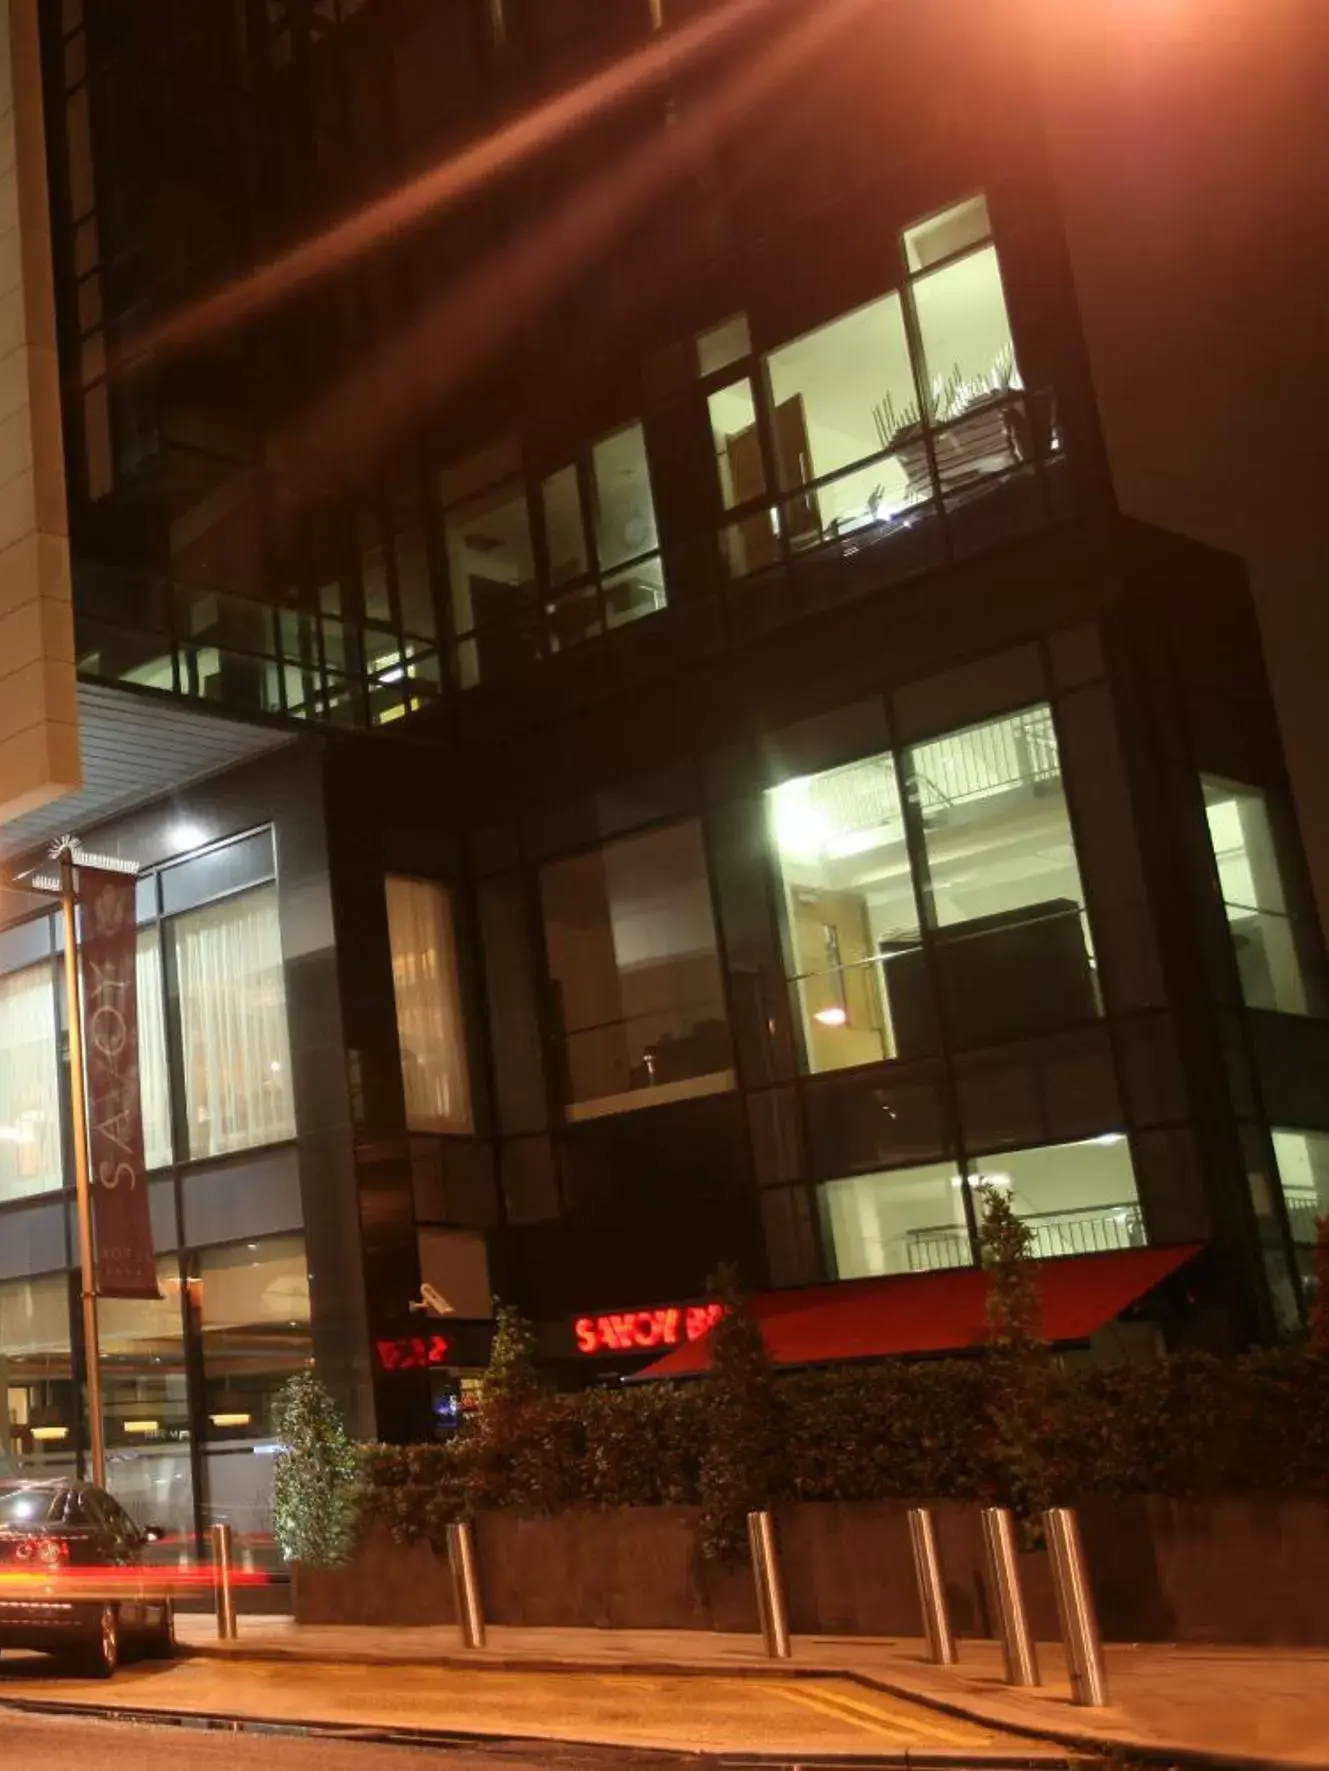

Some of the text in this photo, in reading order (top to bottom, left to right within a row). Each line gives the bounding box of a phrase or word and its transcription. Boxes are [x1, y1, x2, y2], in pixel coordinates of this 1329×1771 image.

[90, 961, 136, 1191] SAVOY
[100, 1246, 153, 1262] HOTL
[575, 1303, 732, 1353] SAVOY BA
